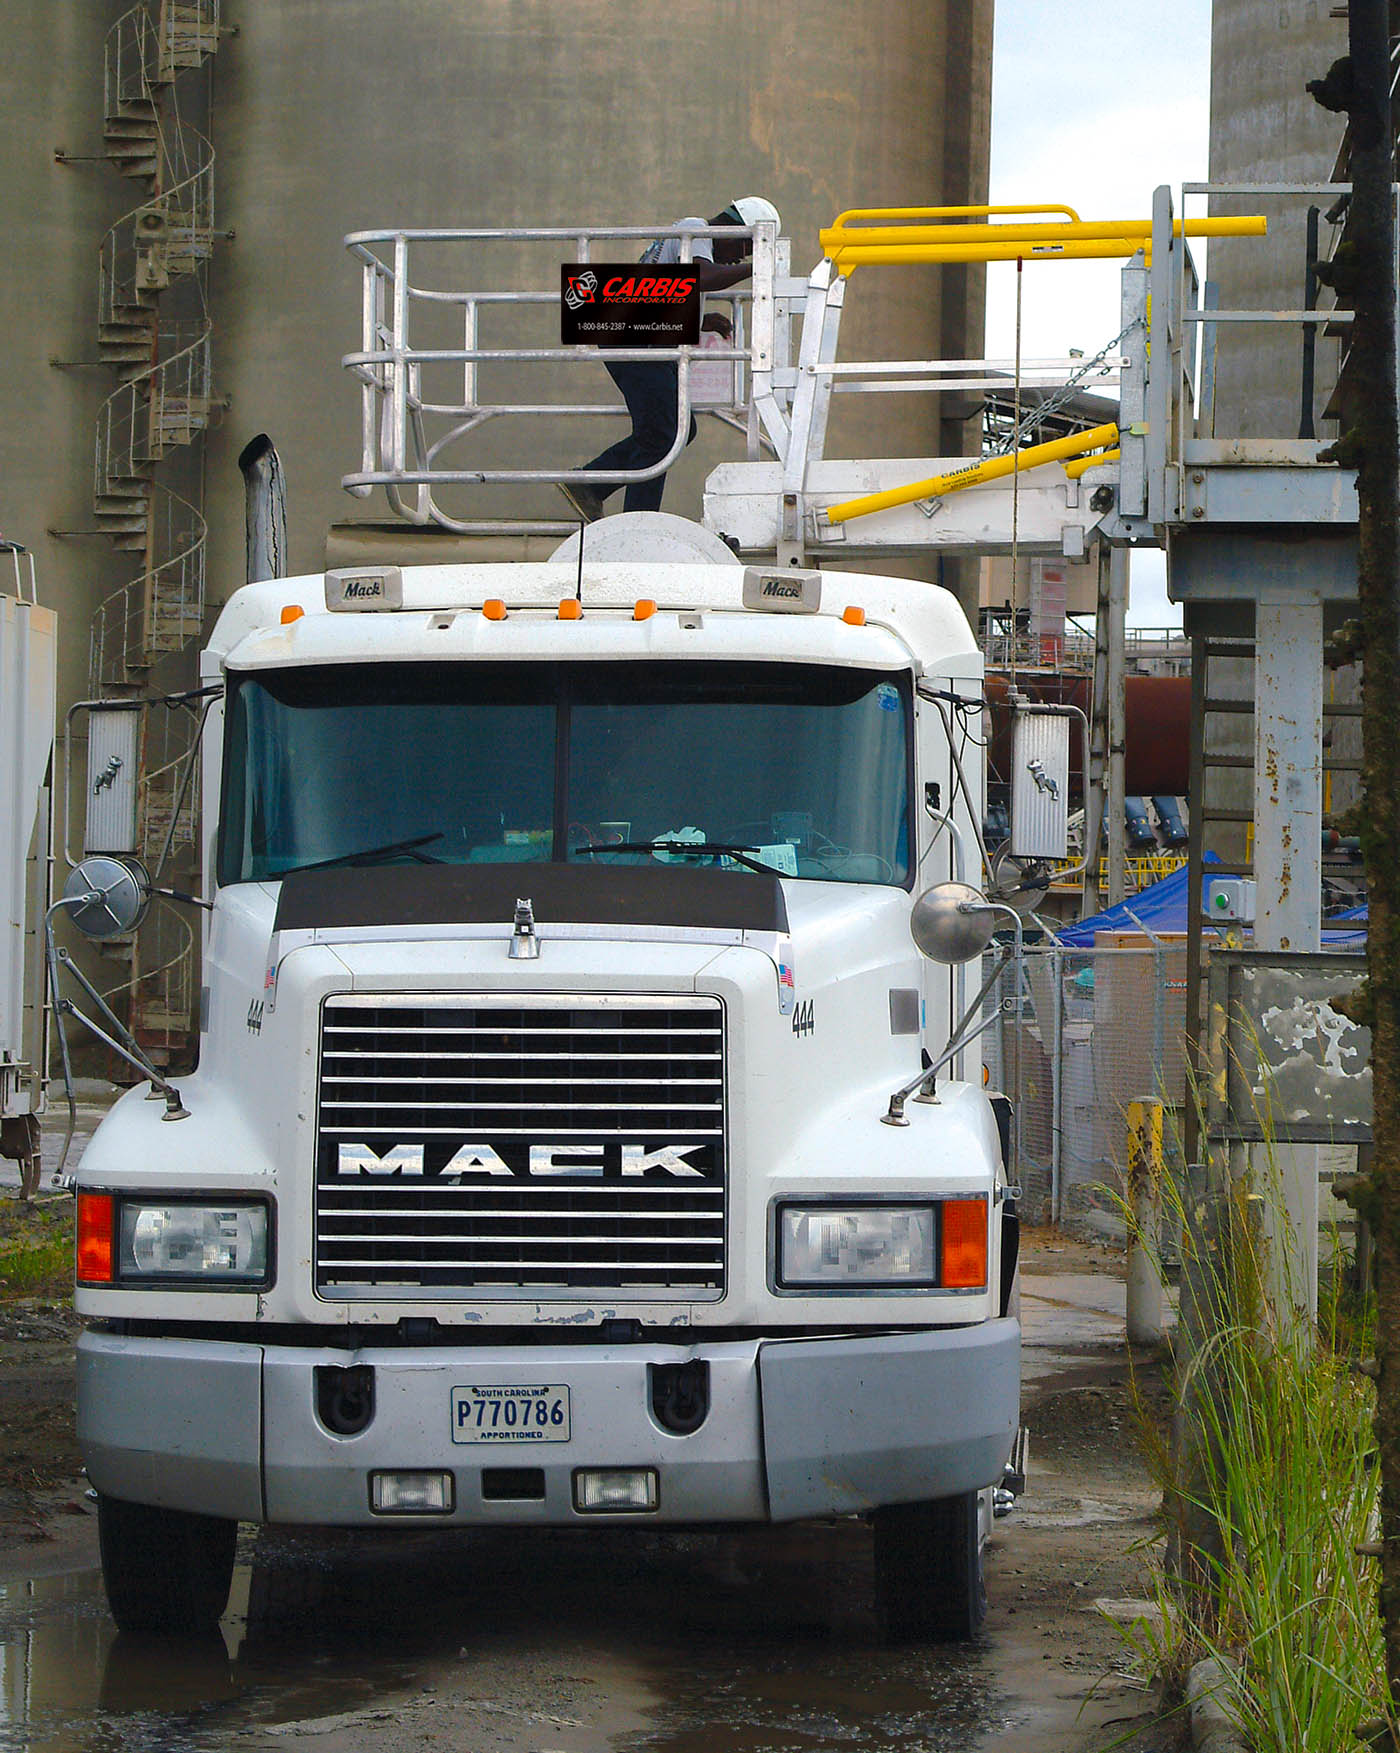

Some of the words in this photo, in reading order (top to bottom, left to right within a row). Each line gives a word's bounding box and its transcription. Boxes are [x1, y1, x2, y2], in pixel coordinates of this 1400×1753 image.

[602, 277, 697, 297] CARBIS
[577, 322, 626, 331] 1-800-845-2387
[633, 322, 683, 331] www.Carbis.net
[344, 582, 381, 597] Mack
[763, 582, 799, 598] Mack
[247, 998, 264, 1037] 444
[792, 999, 814, 1039] 444
[338, 1143, 707, 1178] MACK
[475, 1389, 503, 1397] SOUTH
[504, 1388, 546, 1397] CAROLINA
[457, 1400, 564, 1427] P770786
[480, 1431, 543, 1439] APPORTIONED
